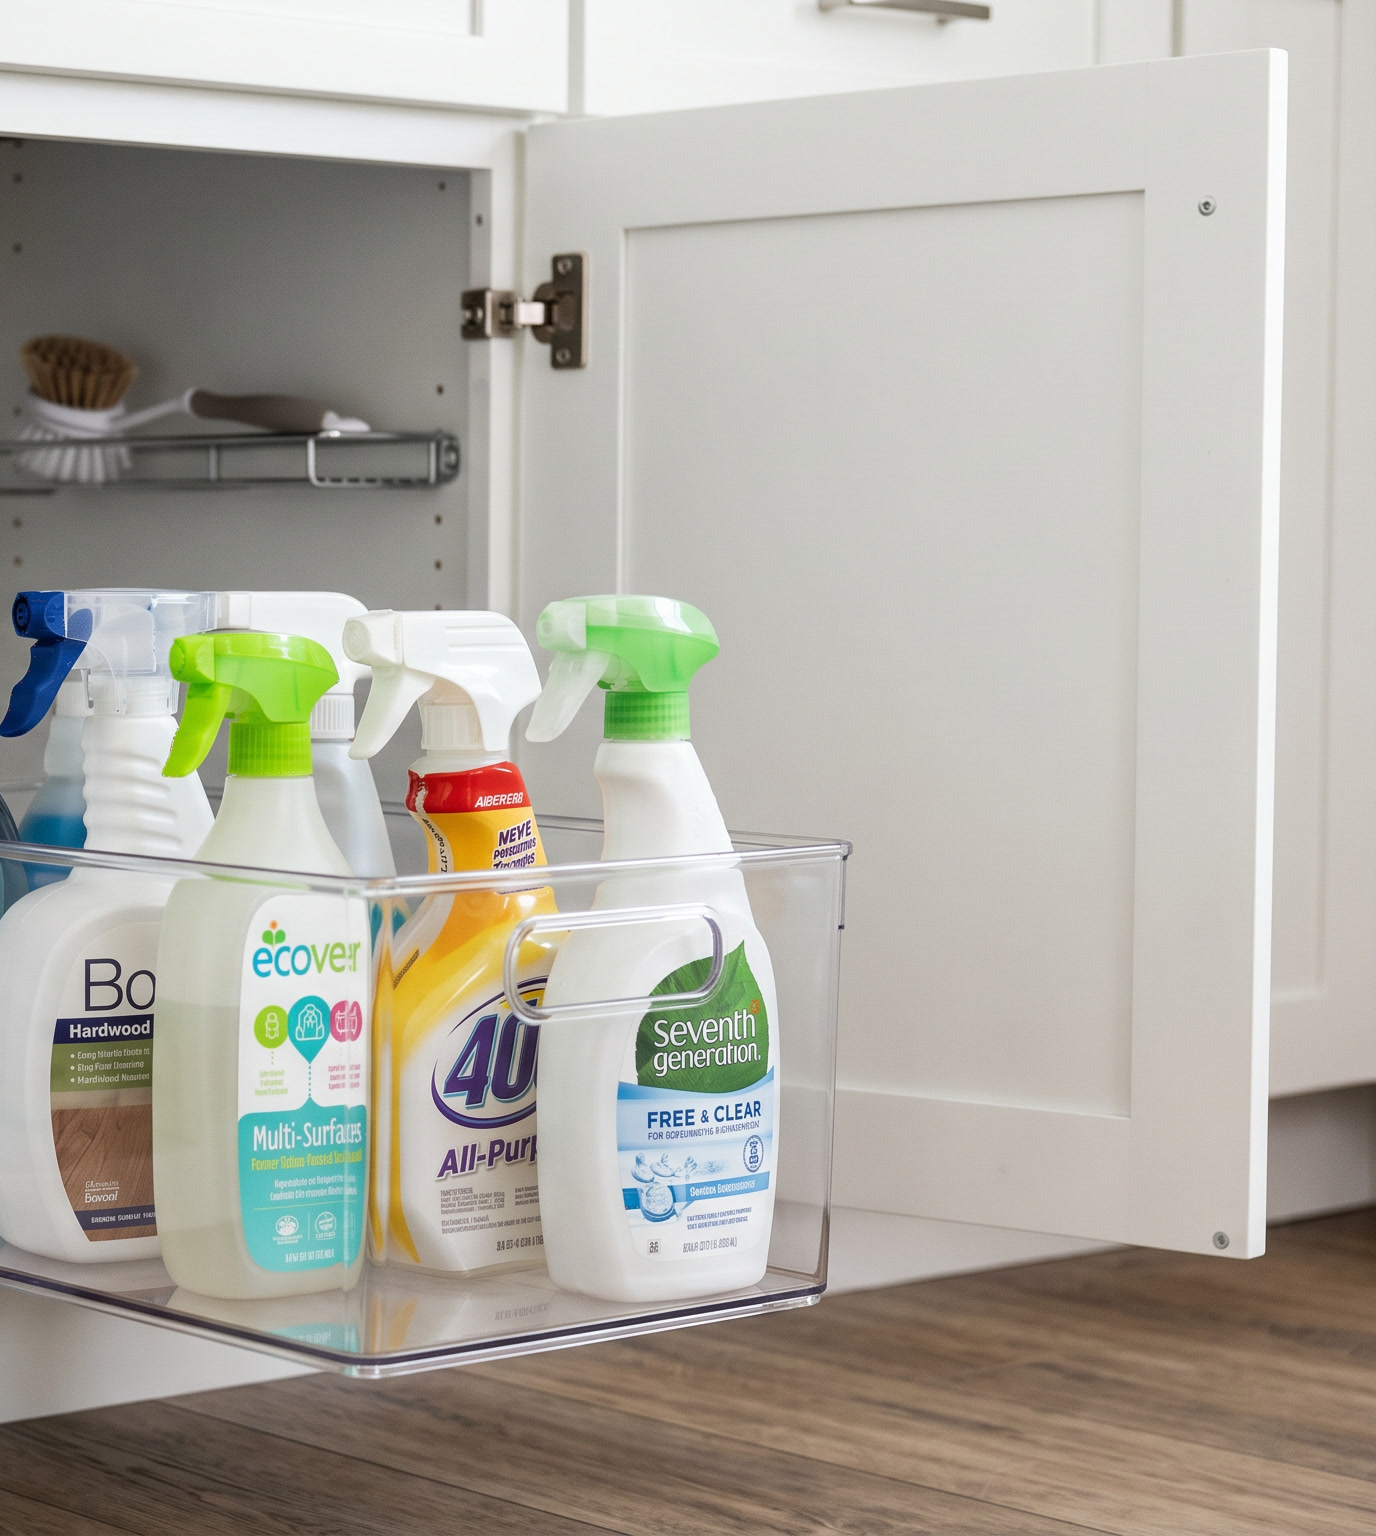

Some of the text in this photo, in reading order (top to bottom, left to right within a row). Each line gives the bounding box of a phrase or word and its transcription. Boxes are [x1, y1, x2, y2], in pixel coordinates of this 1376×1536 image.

[252, 942, 361, 978] ecover
[84, 957, 157, 1012] Bo
[69, 1020, 151, 1039] Hardwood
[442, 1012, 539, 1110] 40
[647, 1100, 762, 1129] FREE & CLEAR
[647, 1131, 664, 1141] FOR
